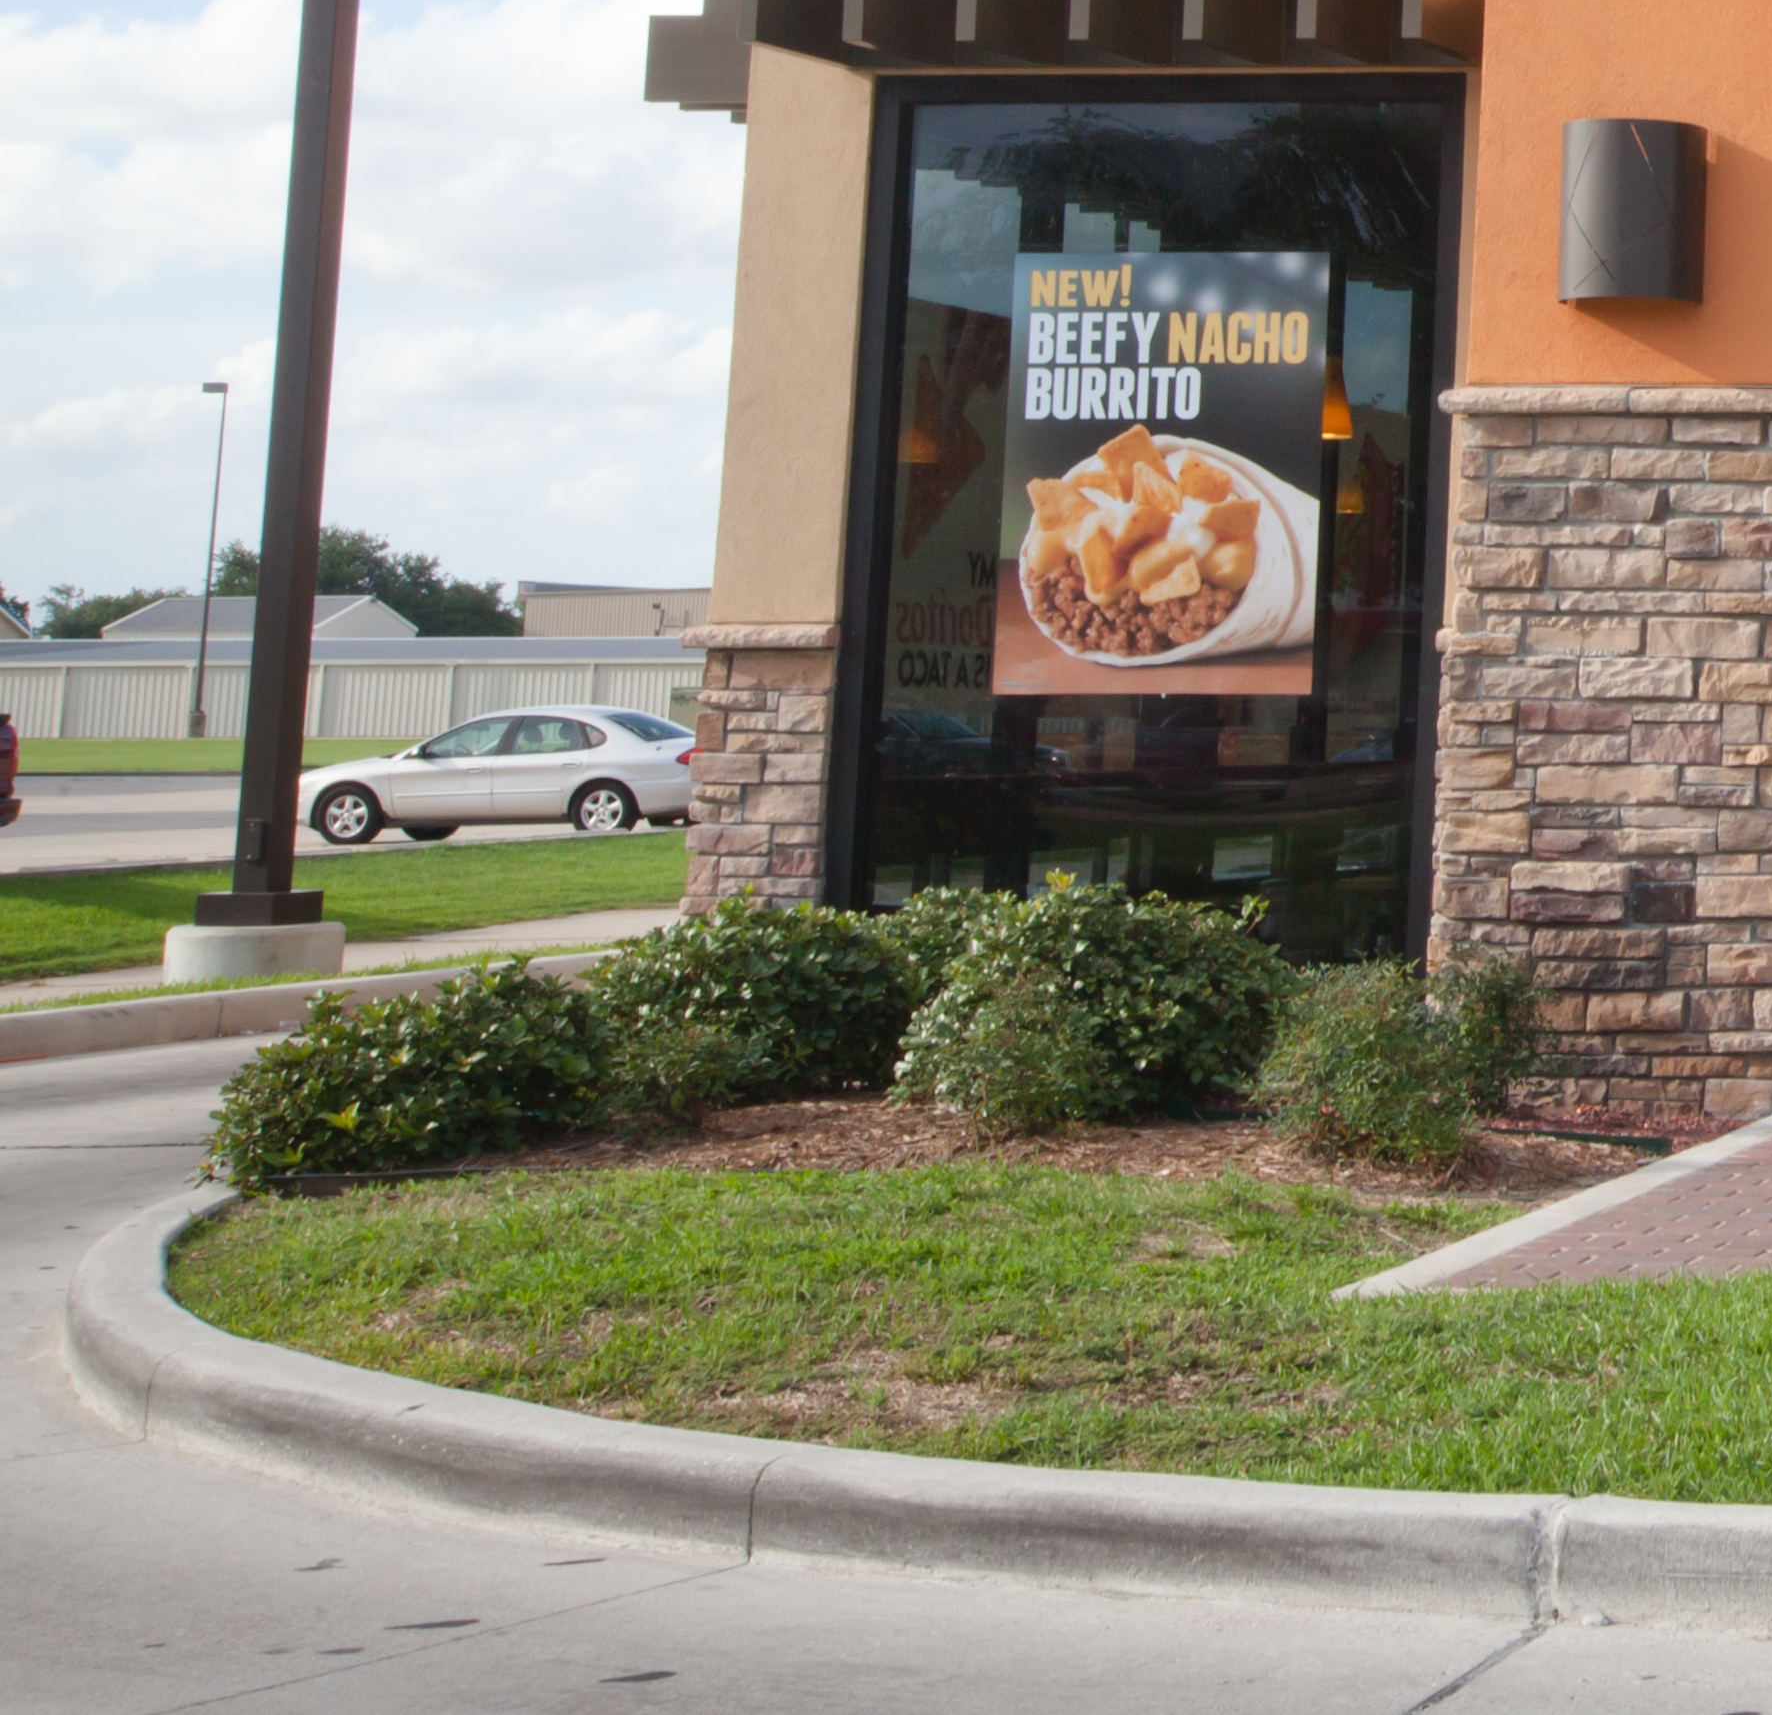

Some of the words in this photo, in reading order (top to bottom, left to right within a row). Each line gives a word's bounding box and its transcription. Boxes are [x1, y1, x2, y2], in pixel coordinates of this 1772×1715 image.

[1030, 264, 1132, 308] NEW!
[1026, 311, 1160, 365] BEEFY
[1167, 310, 1310, 365] NACHO
[1024, 366, 1202, 421] BURRITO
